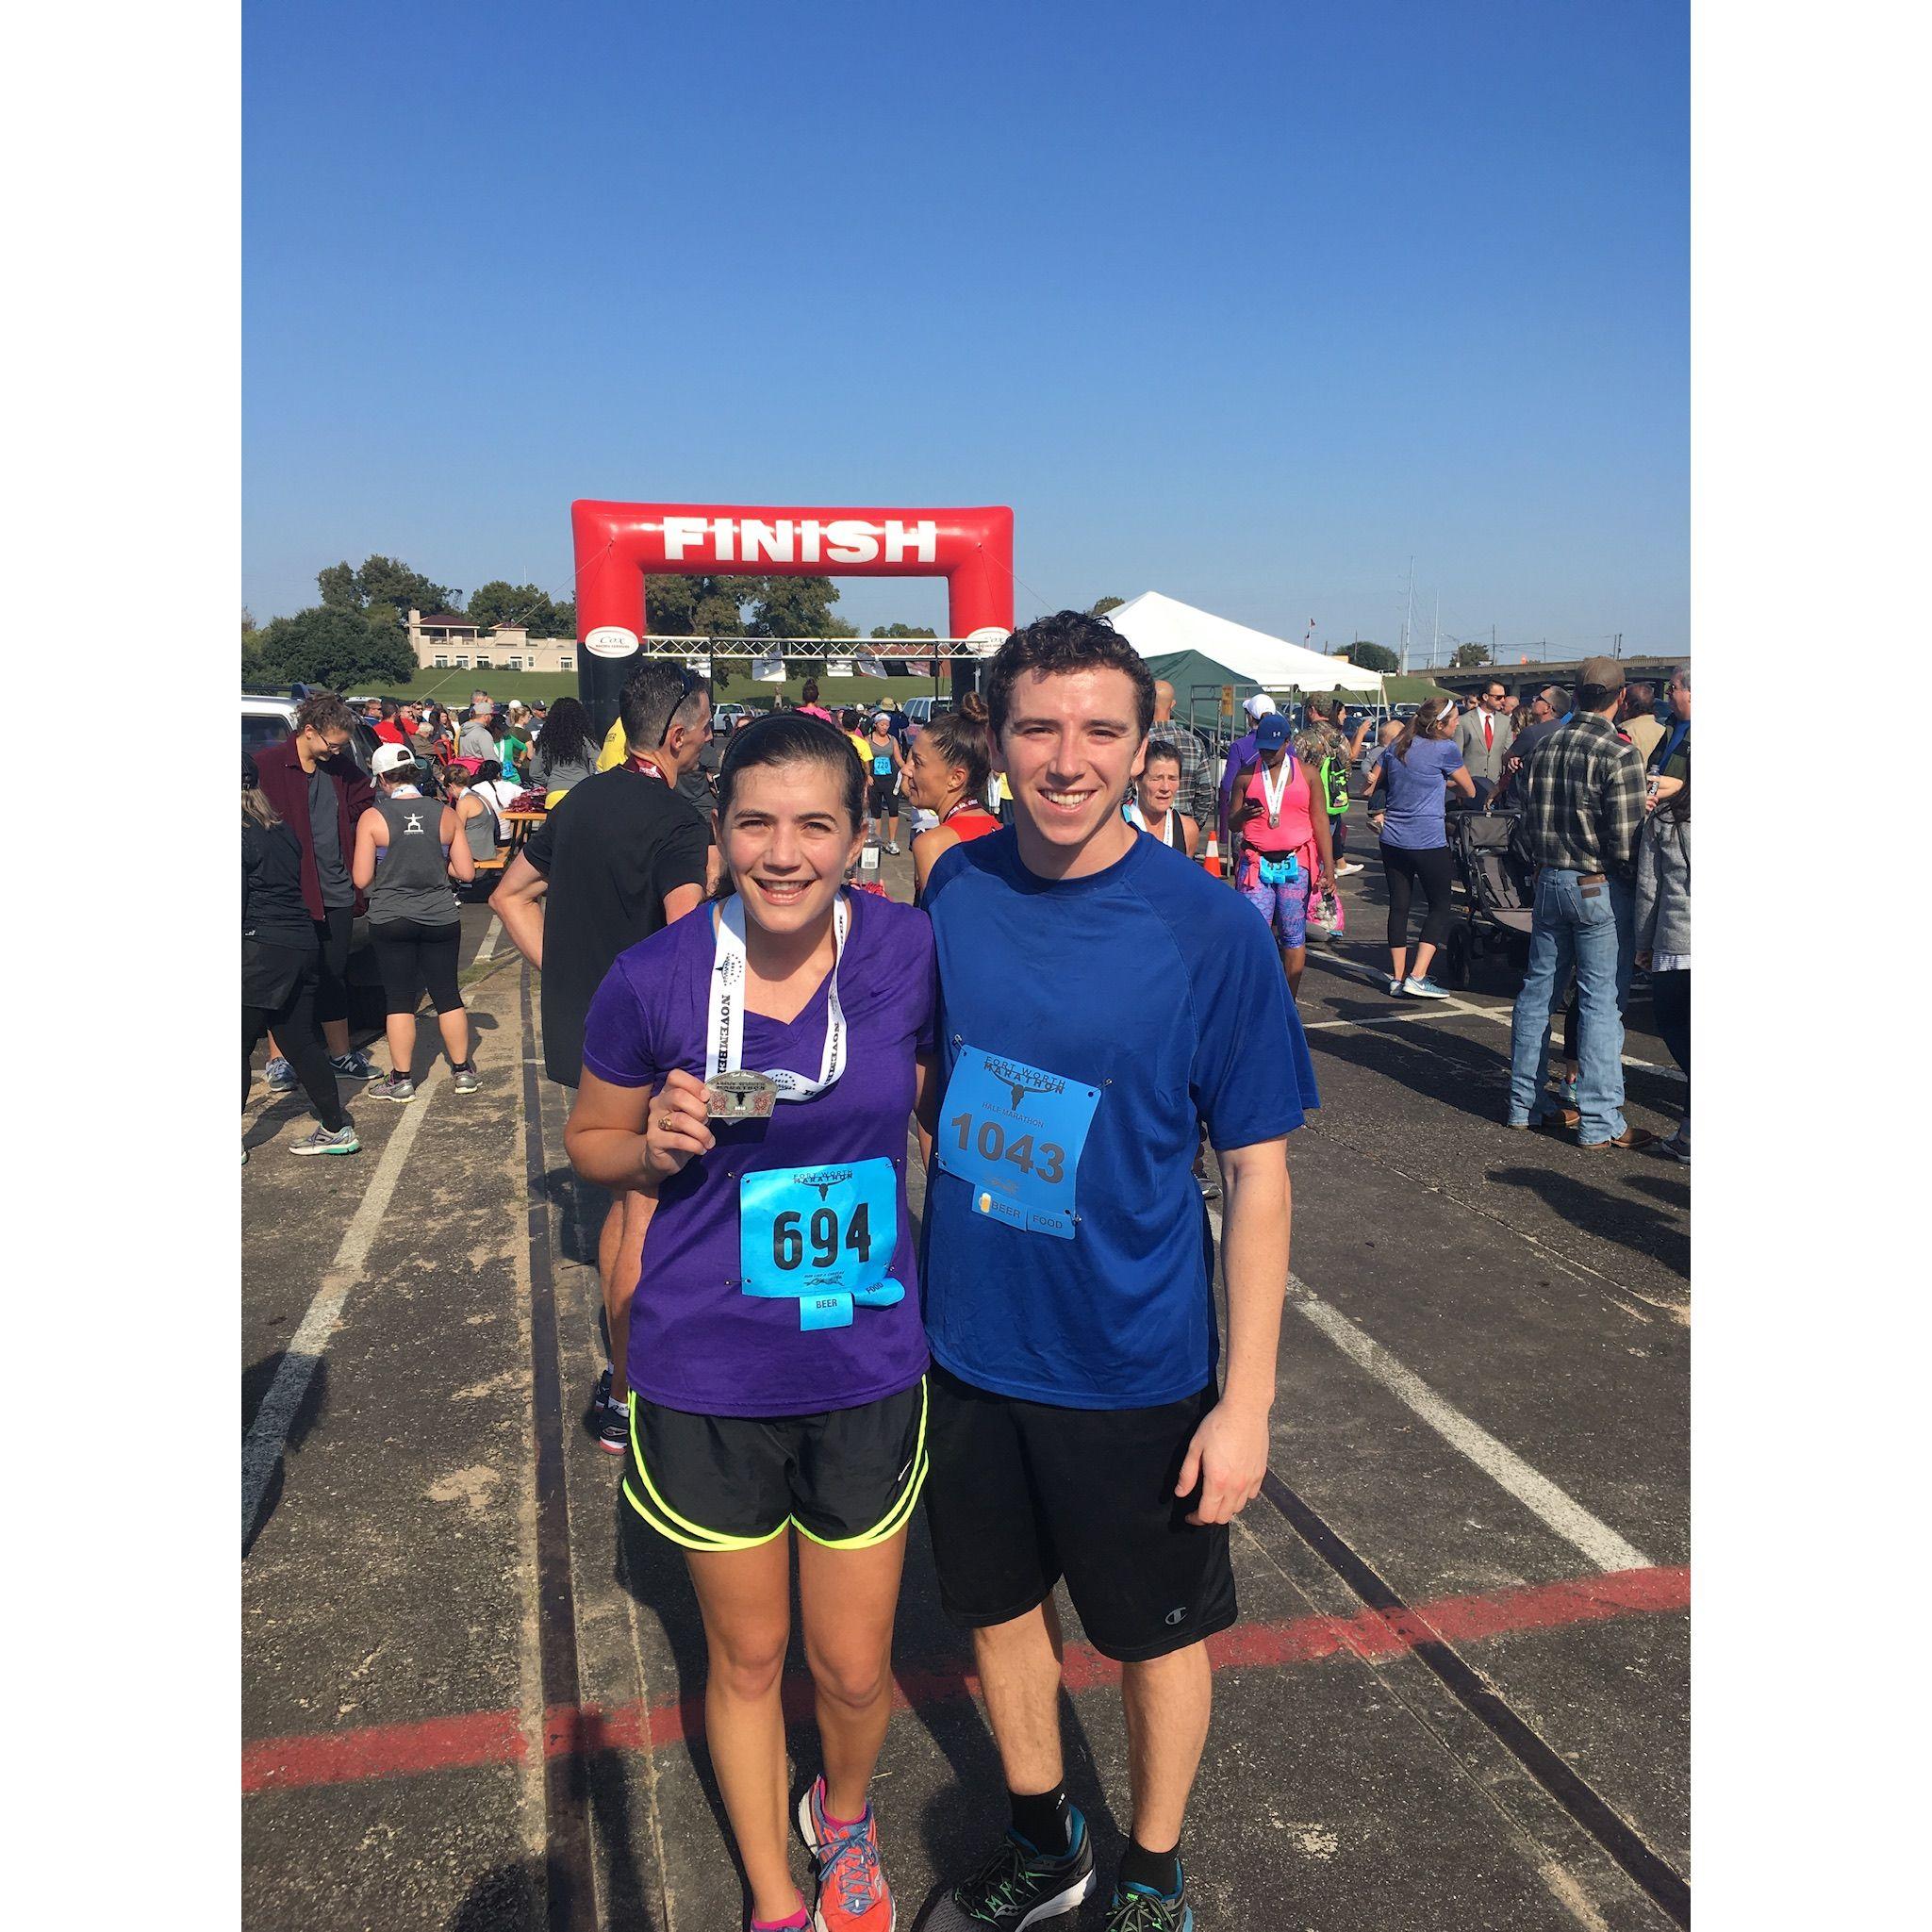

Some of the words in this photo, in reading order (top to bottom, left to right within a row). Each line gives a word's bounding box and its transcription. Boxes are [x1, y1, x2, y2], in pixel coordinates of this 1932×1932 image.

[663, 516, 937, 564] FINISH
[983, 1056, 1016, 1072] FORT
[1021, 1067, 1066, 1088] WORTH
[983, 1062, 1066, 1095] MARATHON
[951, 1112, 1065, 1184] 1043
[821, 1169, 852, 1178] WORTH
[991, 1198, 1021, 1219] BEER
[1032, 1214, 1063, 1230] FOOD
[773, 1202, 871, 1271] 694
[816, 1298, 837, 1310] BEER
[866, 1281, 884, 1296] FOOD
